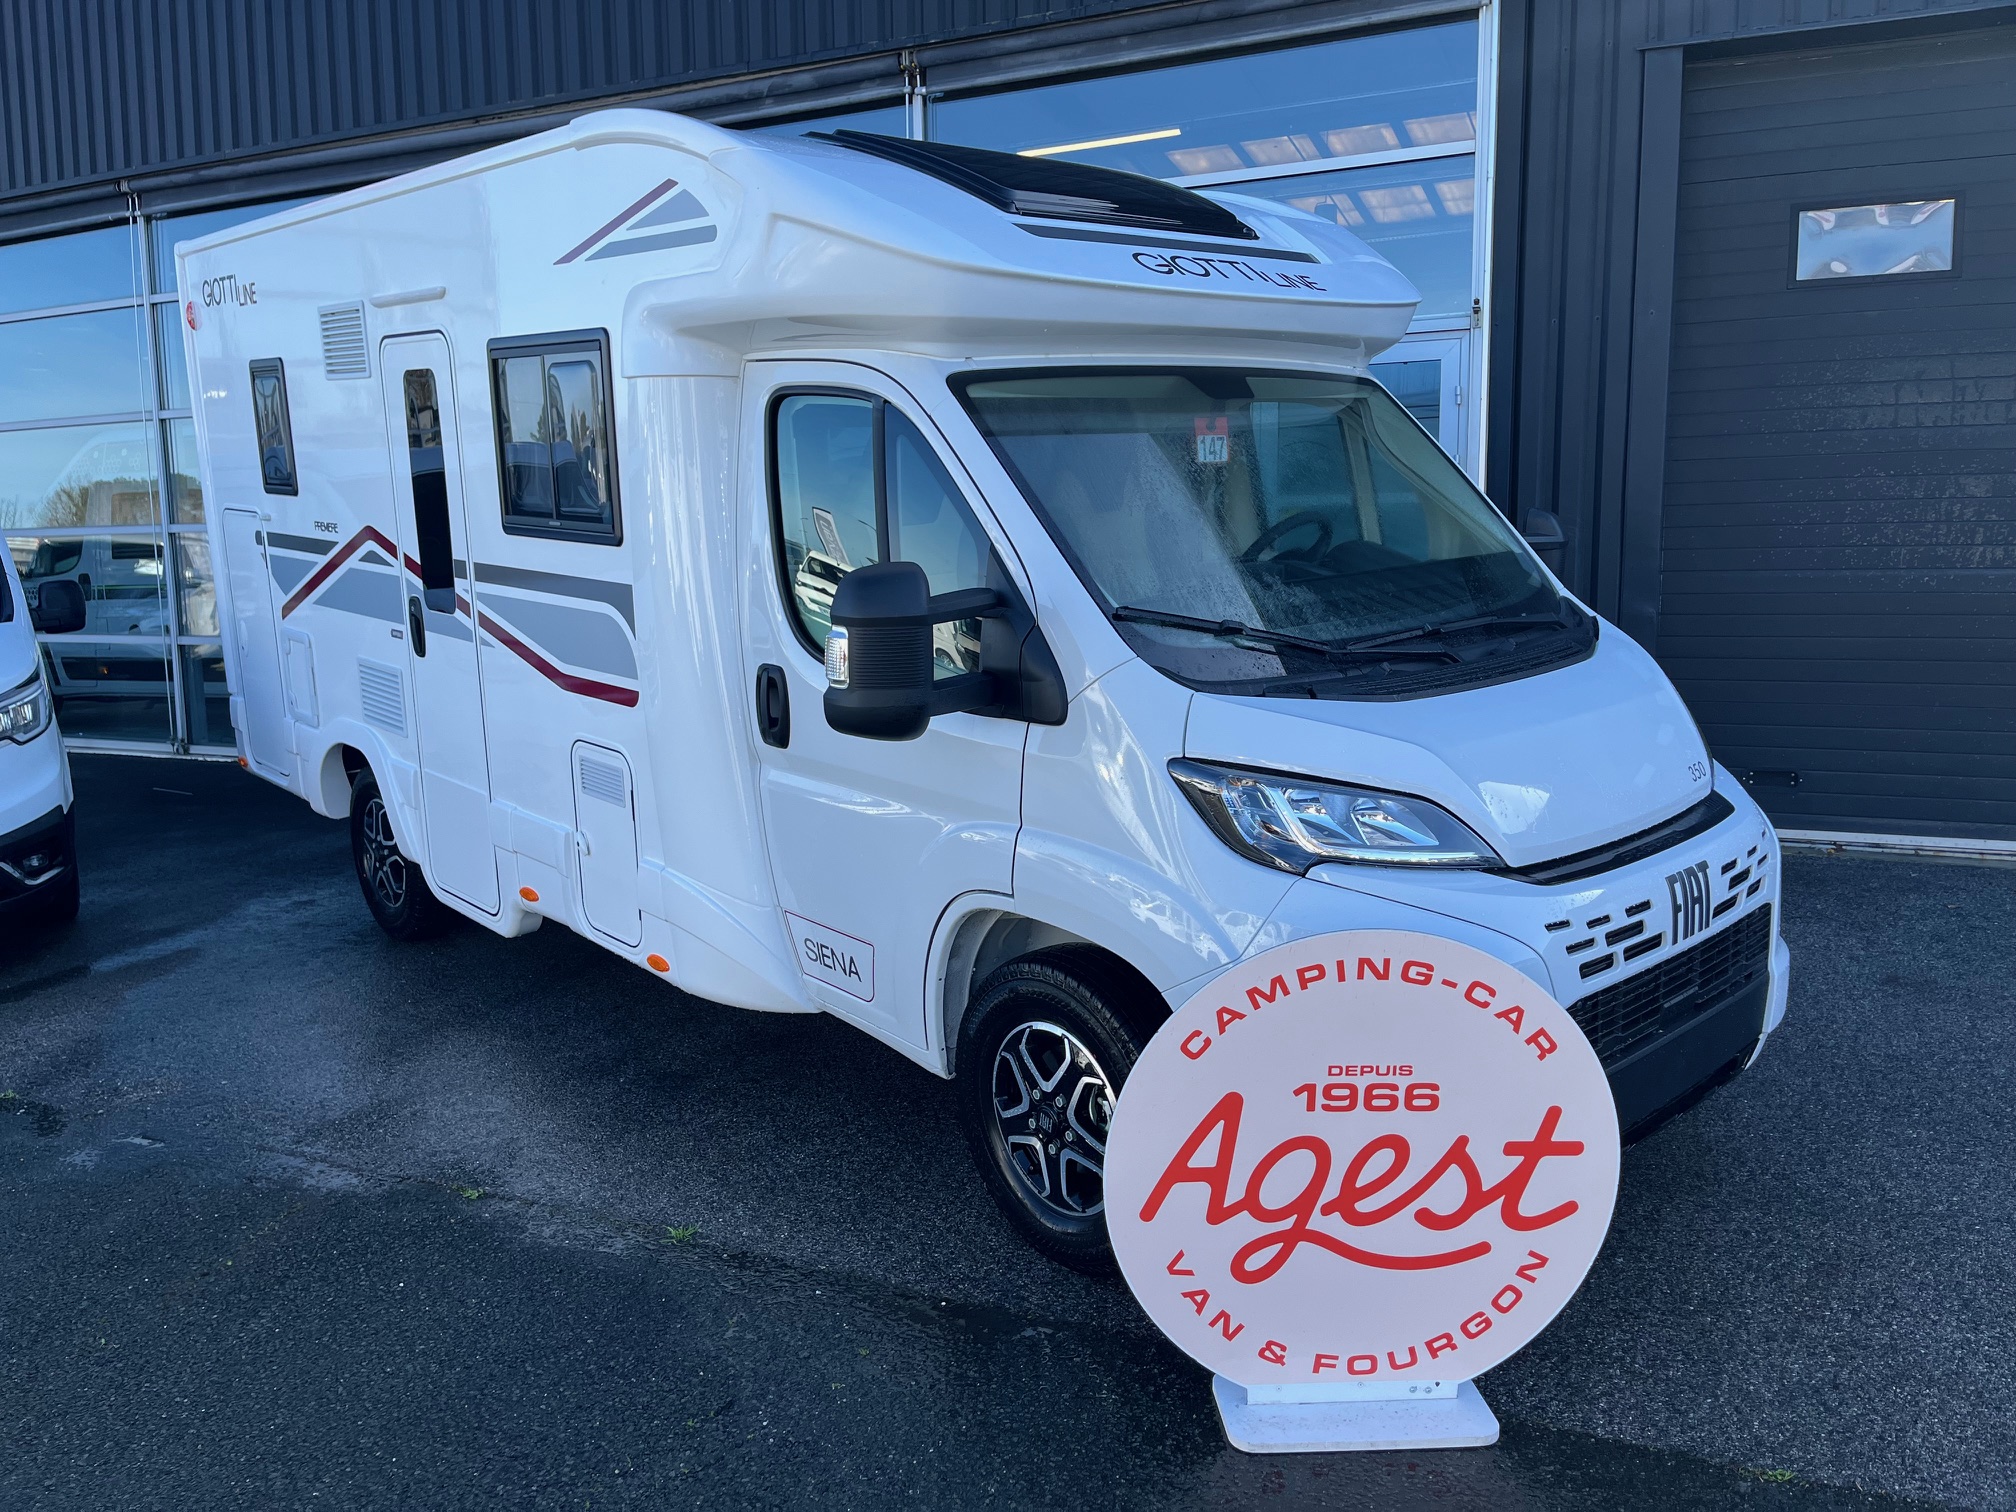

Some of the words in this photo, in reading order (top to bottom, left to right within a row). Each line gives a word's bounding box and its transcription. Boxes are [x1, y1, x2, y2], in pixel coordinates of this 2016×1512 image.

[1200, 436, 1225, 461] 147
[1688, 761, 1706, 782] 350
[1665, 860, 1709, 946] FIAT
[804, 937, 863, 983] SIENA
[1179, 957, 1558, 1061] CAMPING-CAR
[1327, 1064, 1413, 1077] DEPUIS
[1292, 1082, 1440, 1112] 1966
[1138, 1091, 1585, 1285] Agest
[1166, 1249, 1245, 1342] VAN
[1257, 1339, 1288, 1367] &
[1311, 1250, 1550, 1376] FOURGON
